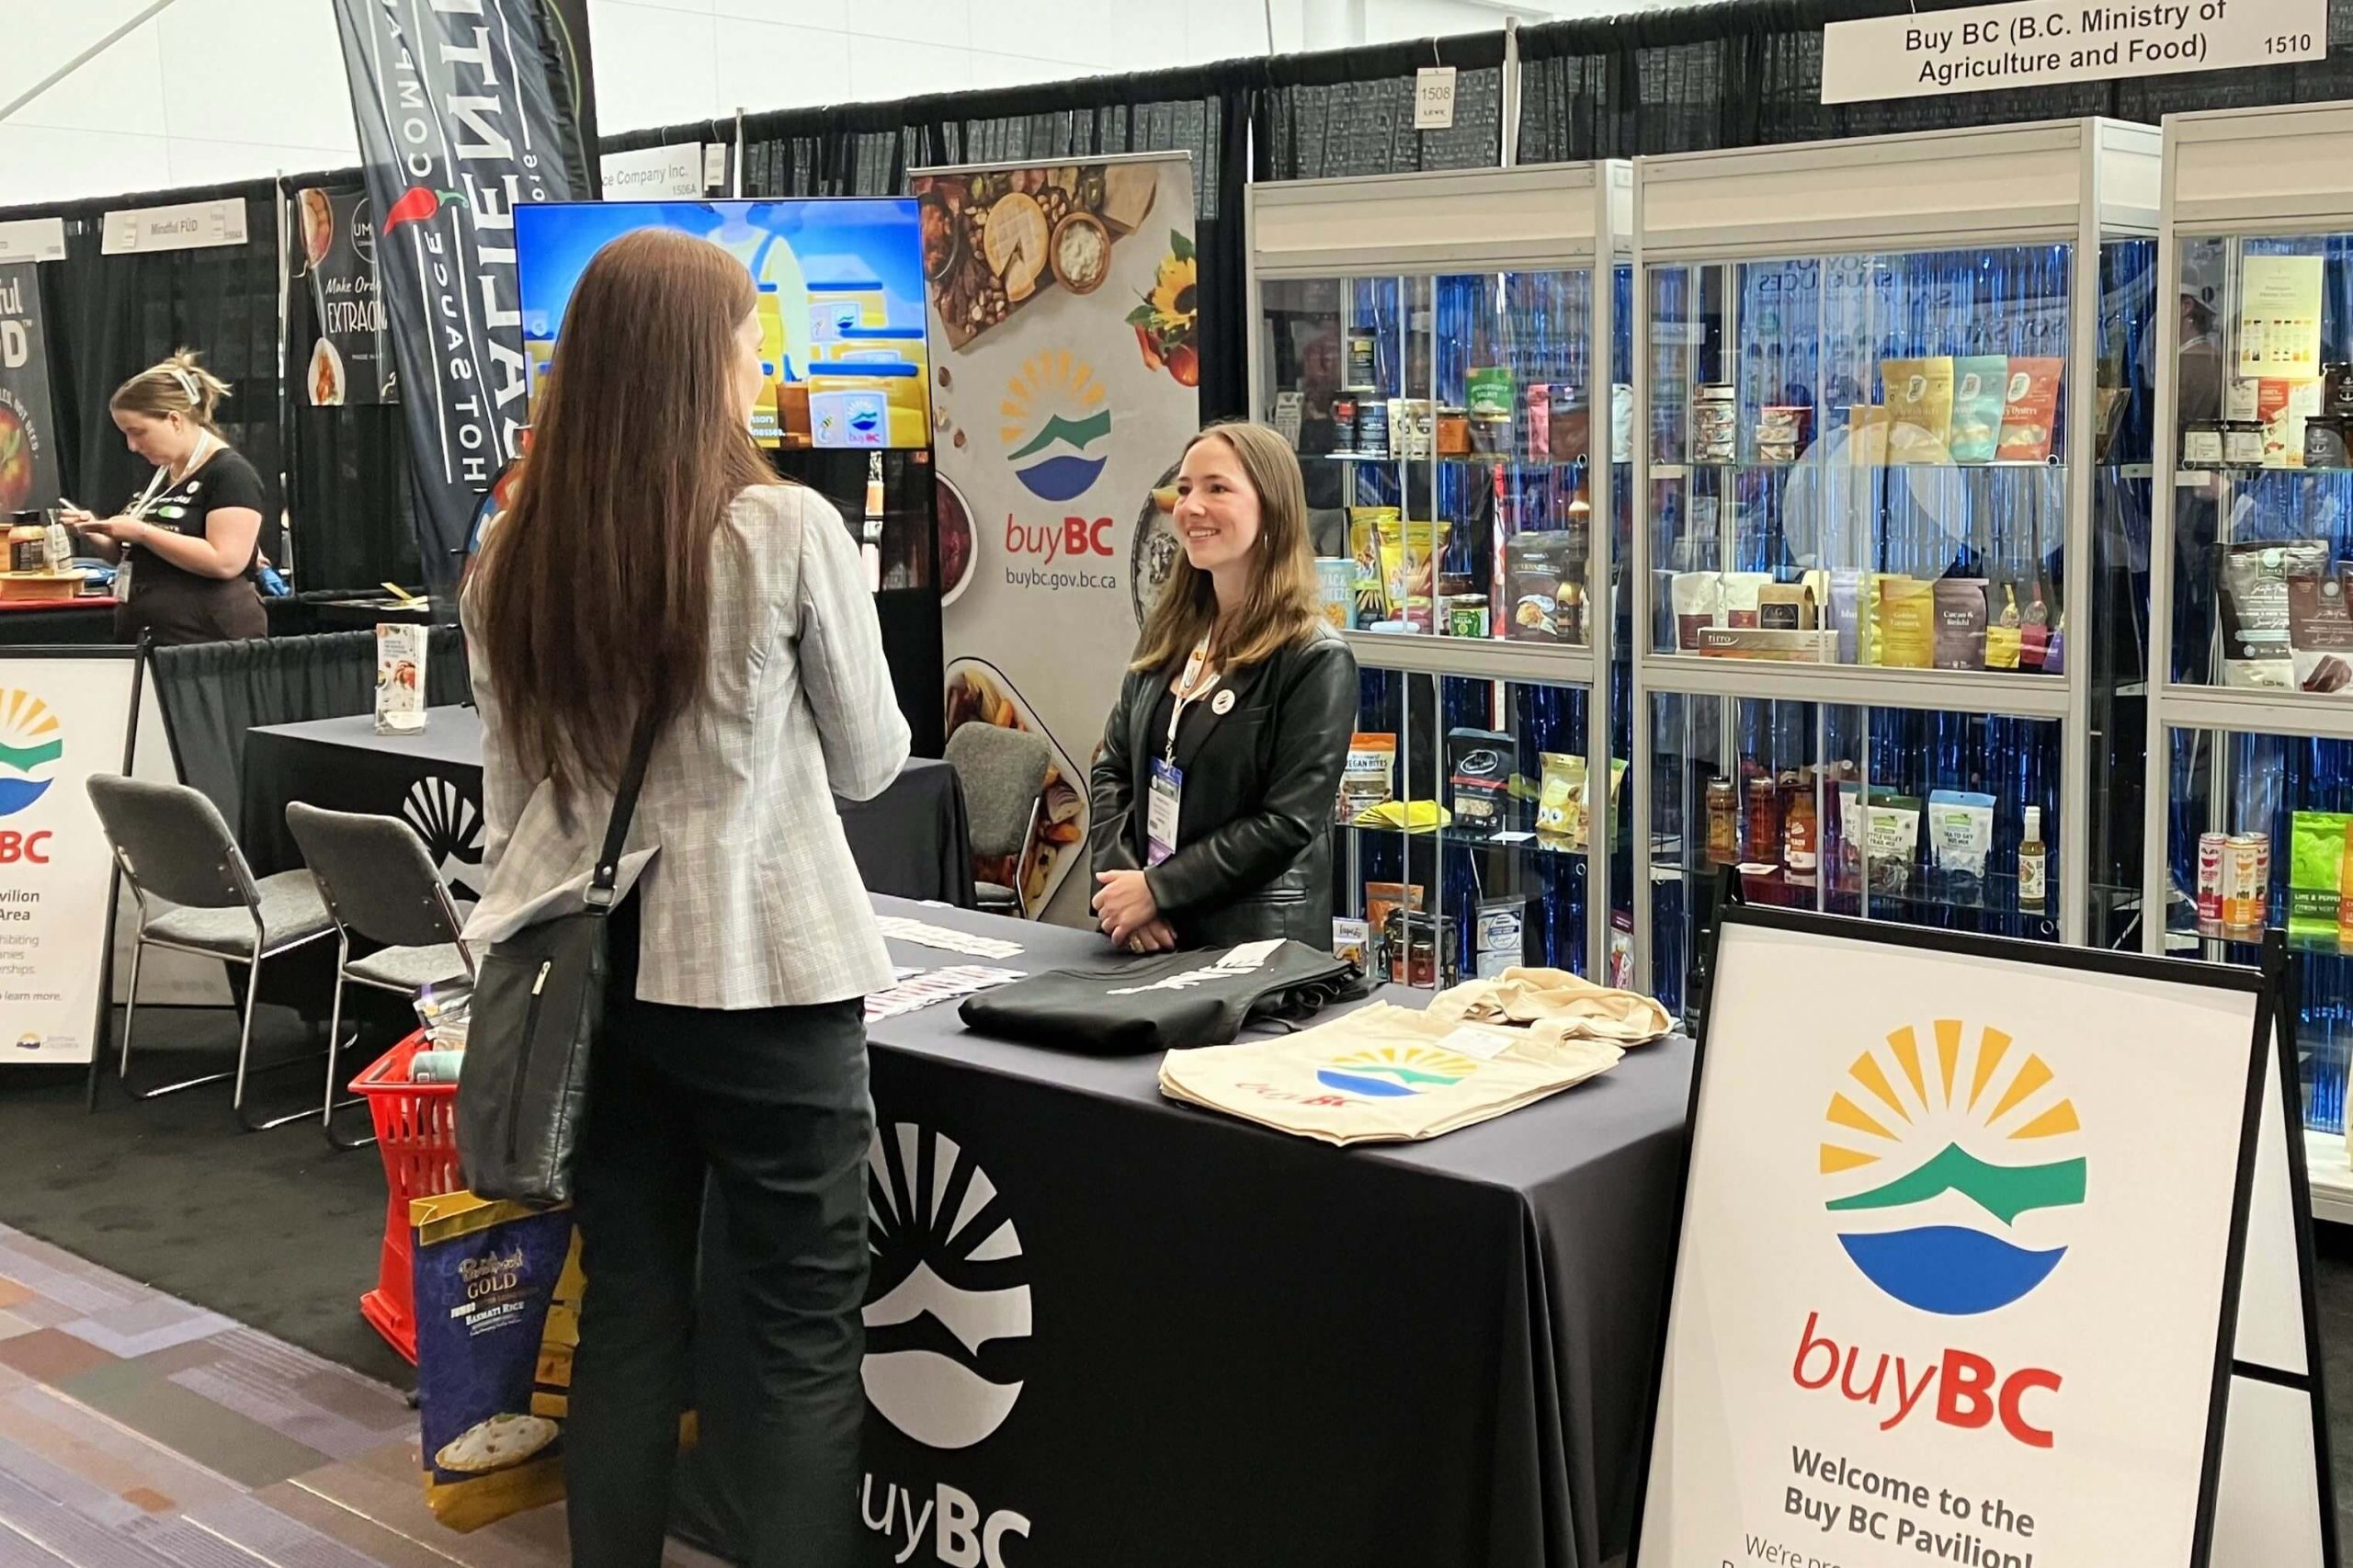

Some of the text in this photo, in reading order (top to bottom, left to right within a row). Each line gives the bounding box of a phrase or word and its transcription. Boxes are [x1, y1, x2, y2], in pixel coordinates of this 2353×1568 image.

[1905, 0, 2226, 54] Buy BC (B.C. Ministry of
[1918, 32, 2208, 86] Agriculture and Food)
[2264, 34, 2312, 56] 1510
[1421, 86, 1451, 101] 1508
[617, 166, 667, 186] Company
[668, 164, 688, 177] Inc.
[325, 277, 352, 295] Make
[1006, 512, 1114, 565] buyBC
[1006, 566, 1116, 591] buybc.gov.bc.ca
[1943, 610, 1966, 619] Cacao
[1368, 759, 1387, 767] BITES
[5, 992, 63, 1002] learn more.
[467, 1272, 517, 1300] GOLD
[1792, 1311, 2063, 1449] buyBC
[1791, 1445, 2036, 1538] Welcome to the
[861, 1472, 1031, 1568] uyBC
[1784, 1485, 2034, 1568] Buy BC Pavilion!
[1745, 1533, 1803, 1568] We're
